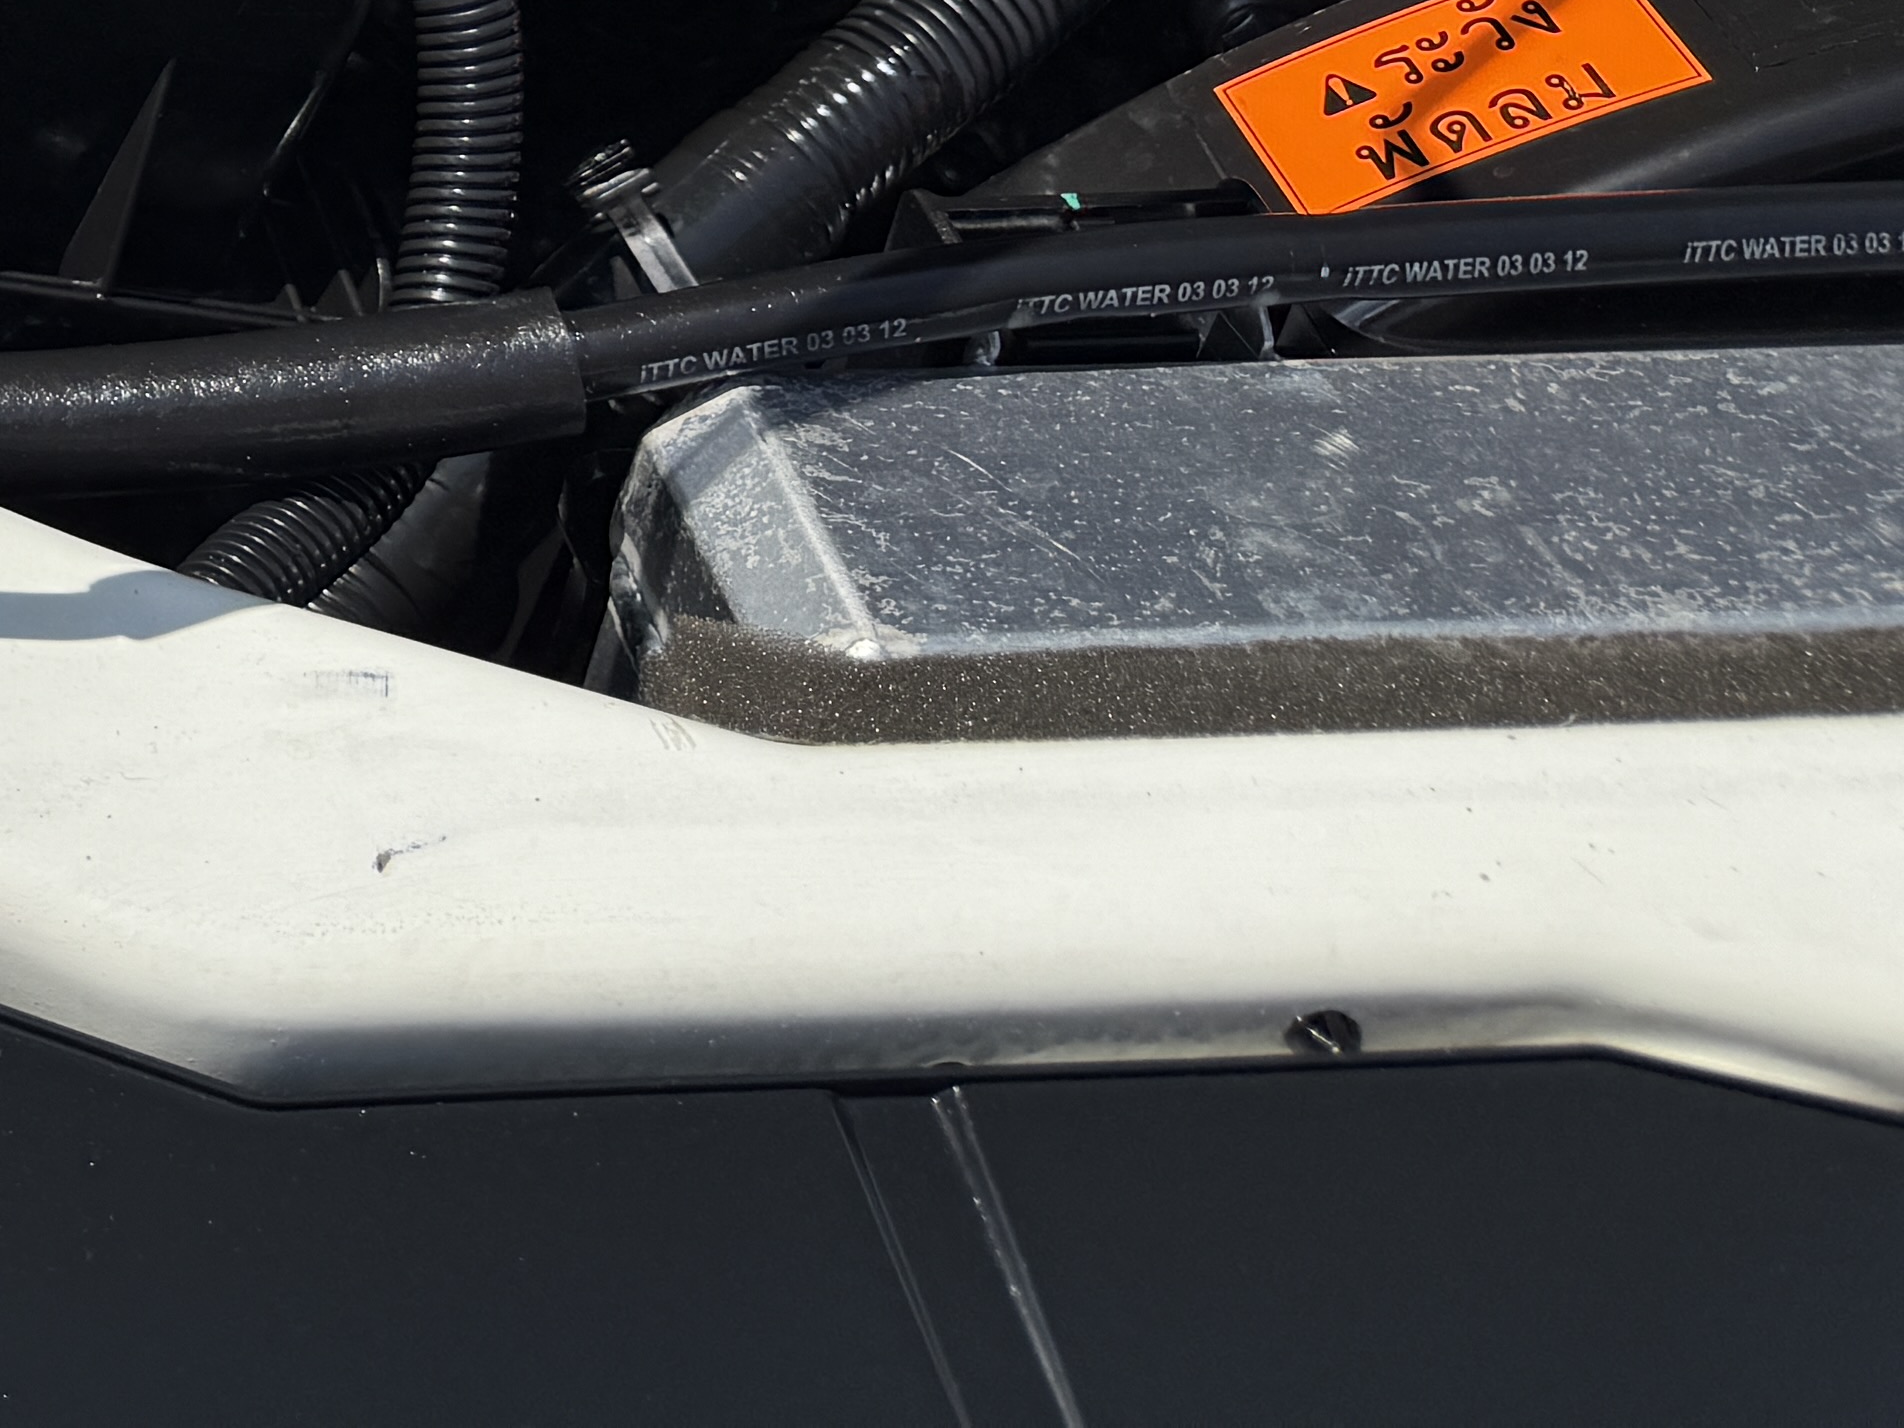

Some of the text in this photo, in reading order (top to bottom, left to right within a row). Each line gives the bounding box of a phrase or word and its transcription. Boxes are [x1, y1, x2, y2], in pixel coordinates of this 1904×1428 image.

[1354, 61, 1618, 181] พัดลม
[1683, 239, 1738, 263] iTTC
[1741, 234, 1828, 260] WATER
[1832, 233, 1859, 256] 03
[1864, 232, 1892, 254] 03
[1342, 248, 1590, 287] iTTC WATER 03 03 12
[1078, 283, 1172, 310] WATER
[1176, 280, 1205, 302] 03
[1211, 277, 1240, 300] 03
[639, 317, 908, 384] iTTC WATER 03 03 12
